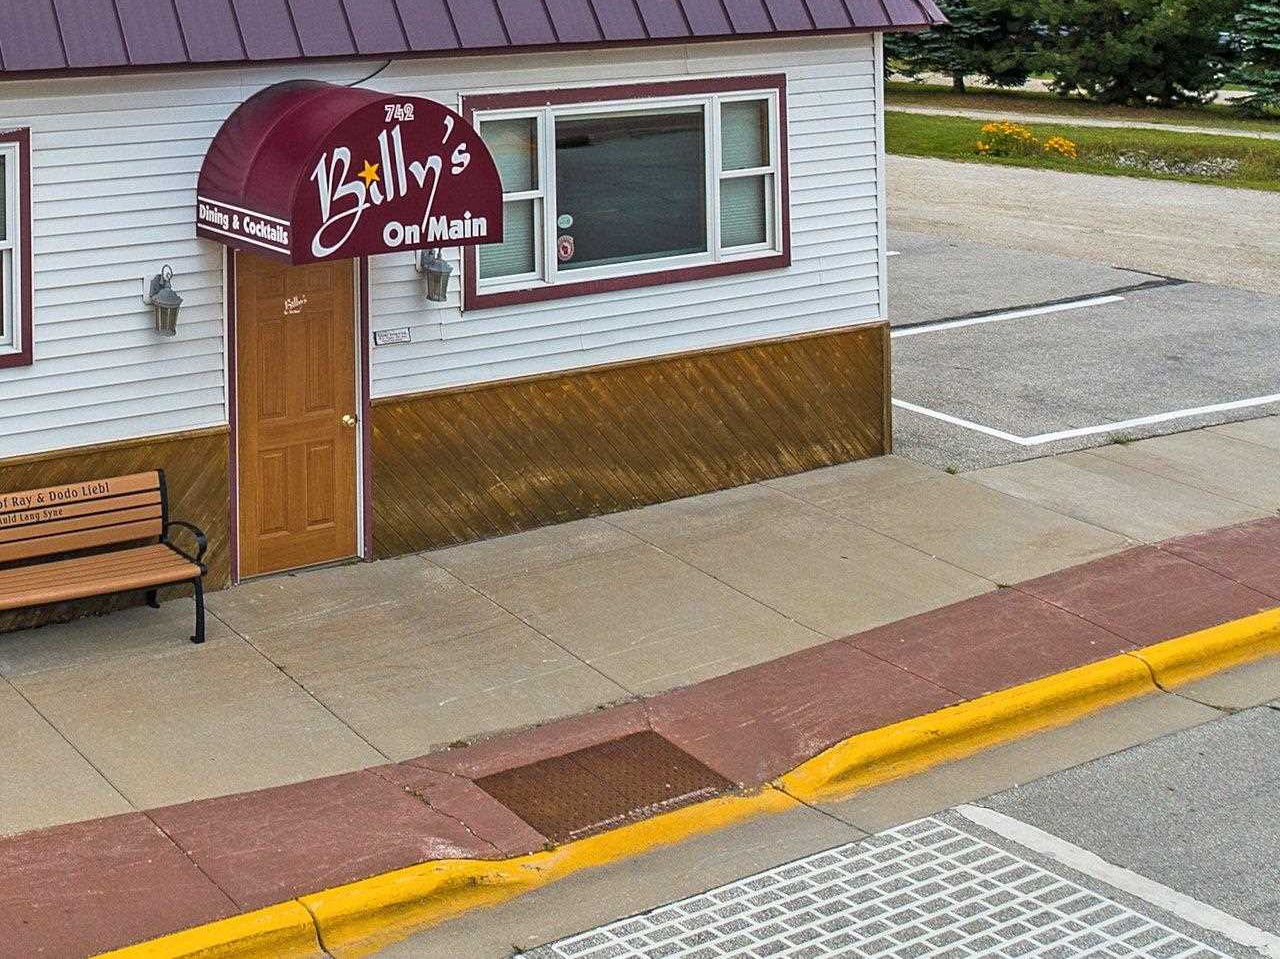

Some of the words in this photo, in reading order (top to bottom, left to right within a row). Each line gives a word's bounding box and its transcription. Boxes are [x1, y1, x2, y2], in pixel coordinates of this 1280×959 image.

[384, 103, 415, 123] 742
[310, 115, 470, 258] Billy's
[199, 204, 229, 230] Dining
[232, 214, 240, 230] &
[243, 216, 289, 245] Cocktails
[383, 221, 419, 247] On
[427, 210, 487, 242] Main
[11, 495, 32, 508] Ray
[36, 492, 45, 503] &
[48, 488, 78, 501] Dodo
[82, 482, 109, 497] Liebl
[19, 512, 40, 522] Lang
[43, 508, 63, 519] Syne
